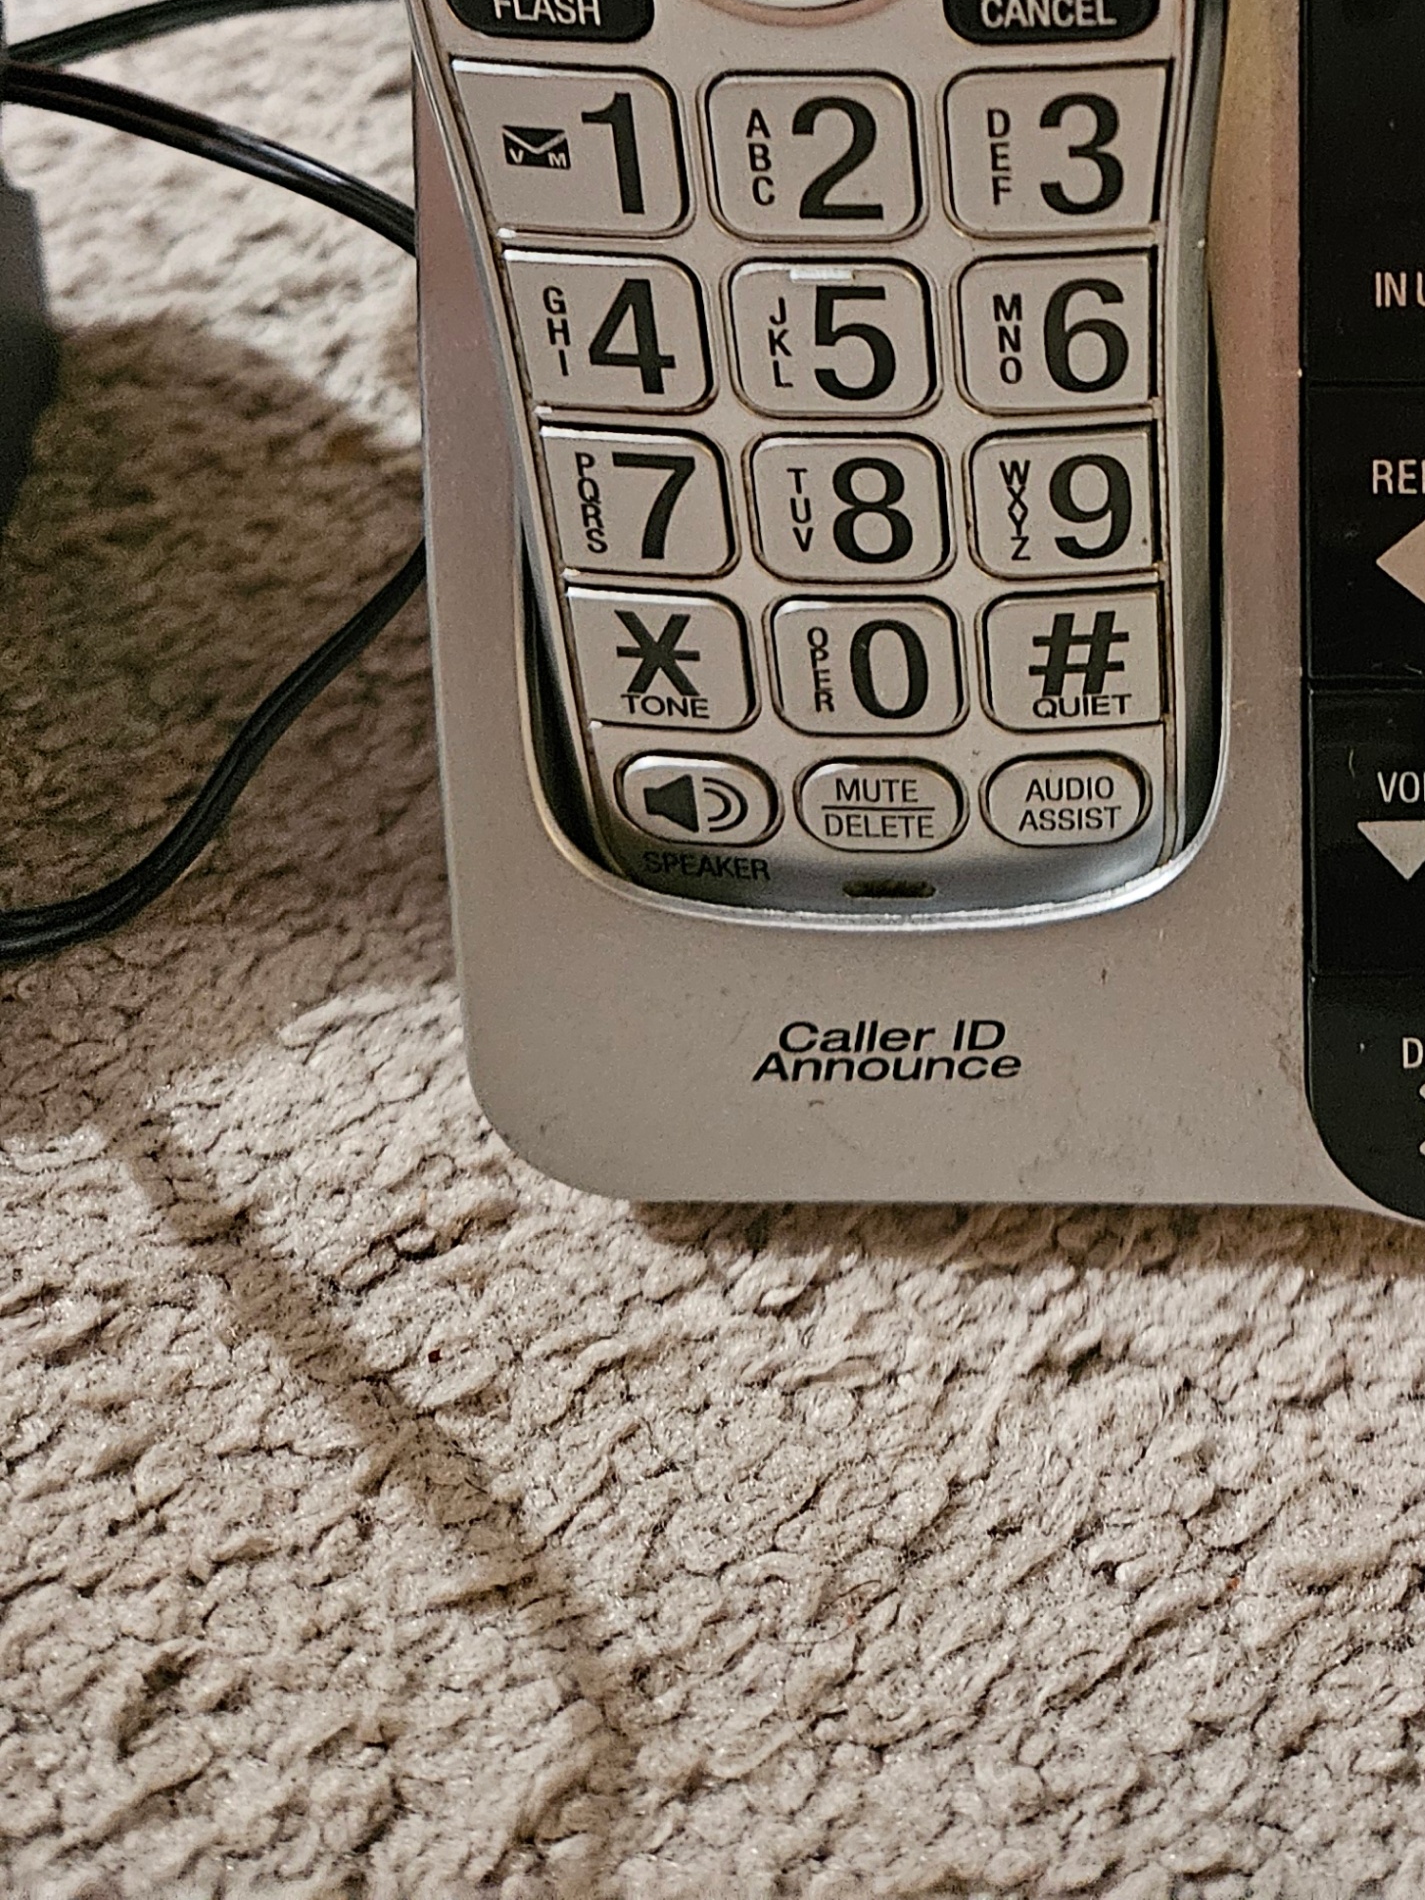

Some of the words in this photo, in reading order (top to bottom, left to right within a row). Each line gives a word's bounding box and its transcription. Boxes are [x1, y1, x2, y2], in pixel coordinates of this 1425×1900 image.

[580, 91, 645, 215] 1
[791, 95, 884, 221] 2
[1039, 92, 1124, 216] 3
[1375, 271, 1407, 308] IN
[588, 277, 677, 395] 4
[814, 284, 897, 401] 5
[1043, 277, 1130, 394] 6
[611, 451, 696, 560] 7
[832, 456, 914, 565] 8
[1048, 453, 1133, 560] 9
[849, 618, 929, 720] 0
[619, 693, 711, 720] TONE
[1031, 694, 1133, 720] QUIET
[835, 777, 919, 803] MUTE
[1018, 805, 1122, 832] ASSIST
[1025, 775, 1115, 803] AUDIO
[824, 813, 934, 839] DELETE
[642, 850, 771, 882] SPEAKER
[751, 1050, 1023, 1083] Announce
[777, 1019, 937, 1054] Caller
[951, 1019, 1006, 1052] ID
